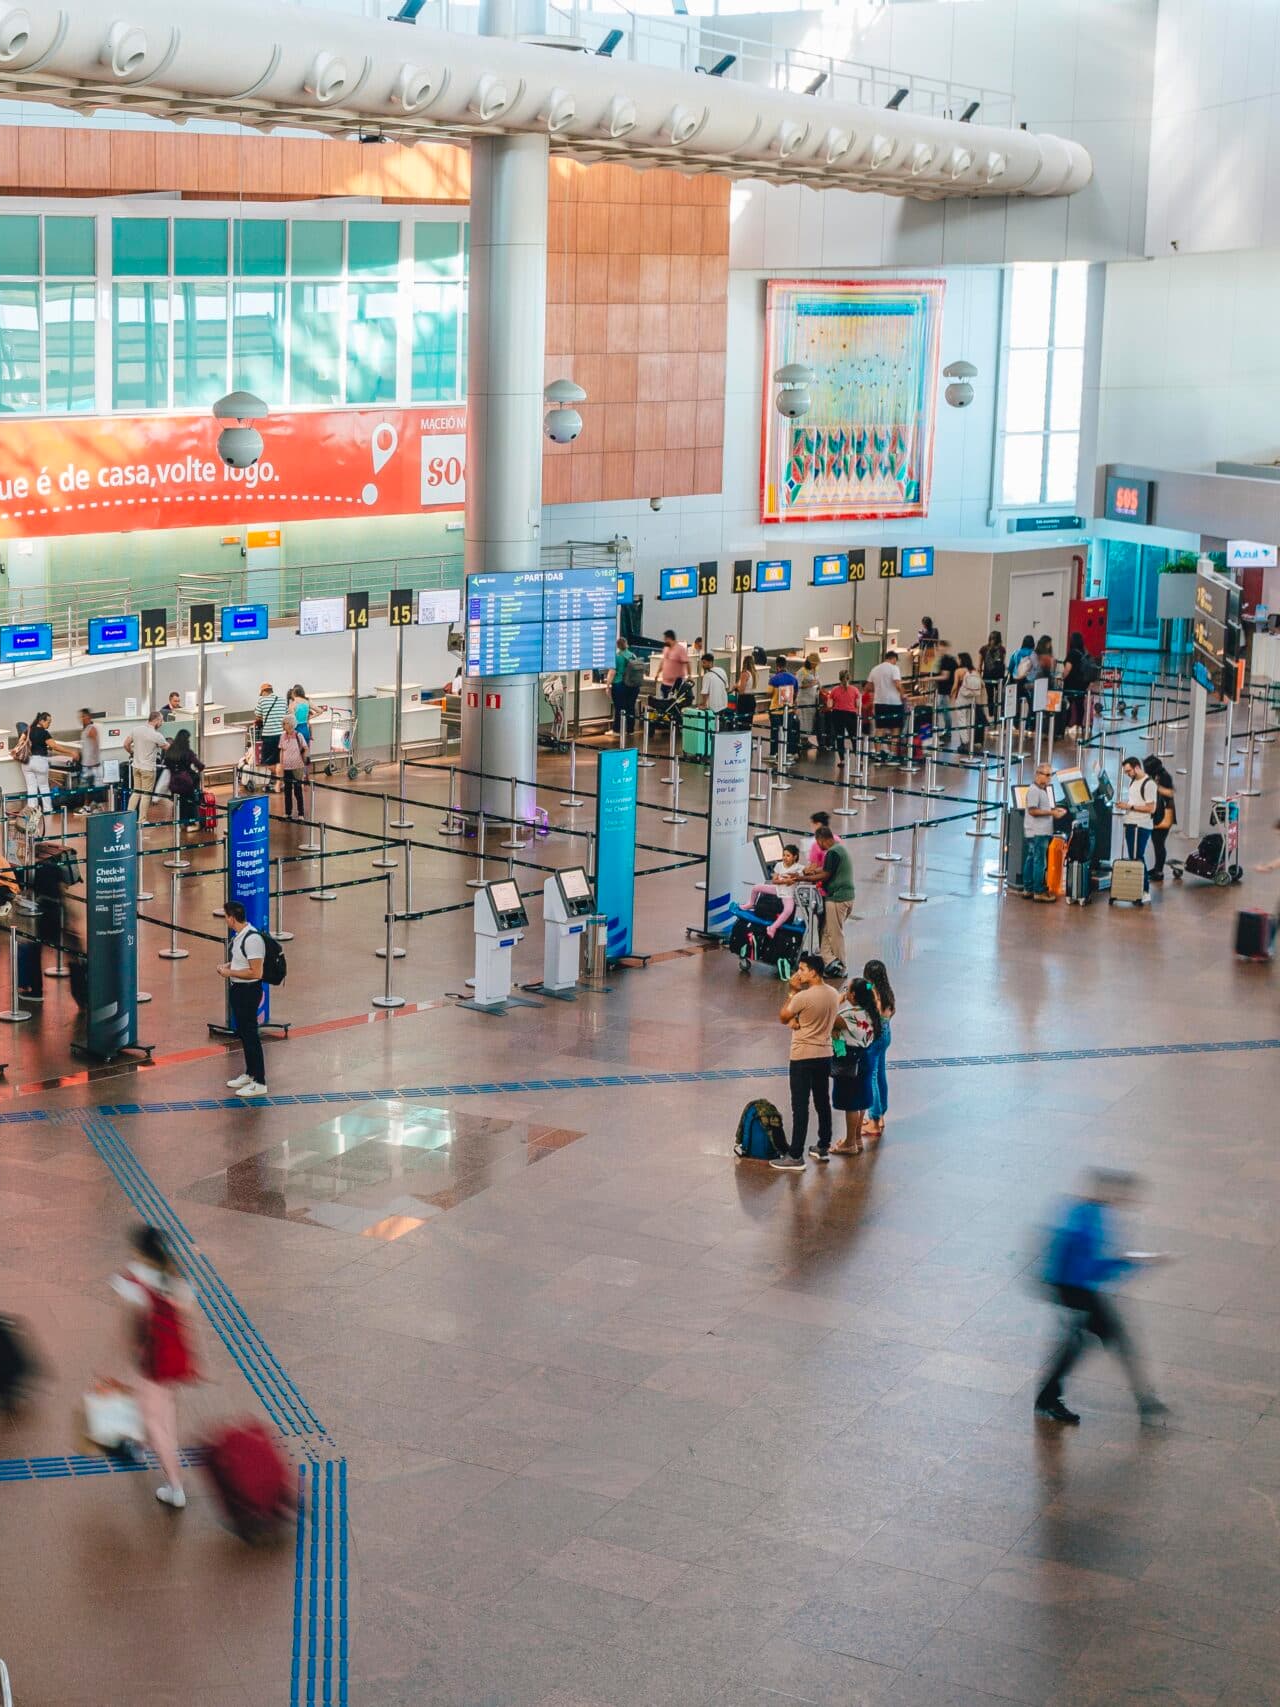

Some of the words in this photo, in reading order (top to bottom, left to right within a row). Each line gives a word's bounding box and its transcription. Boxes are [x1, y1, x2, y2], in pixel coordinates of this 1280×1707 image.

[421, 416, 456, 430] MACEIÓ
[37, 466, 51, 496] é
[59, 464, 90, 492] de
[428, 457, 465, 487] SO
[1233, 550, 1258, 559] Azul
[849, 563, 864, 580] 20
[881, 560, 895, 576] 21
[524, 572, 564, 582] PARTIDAS
[700, 576, 717, 593] 18
[735, 574, 751, 592] 19
[348, 608, 368, 627] 14
[392, 605, 411, 624] 15
[144, 626, 166, 647] 12
[193, 621, 214, 641] 13
[103, 843, 131, 853] LATAM
[96, 875, 126, 884] Premium
